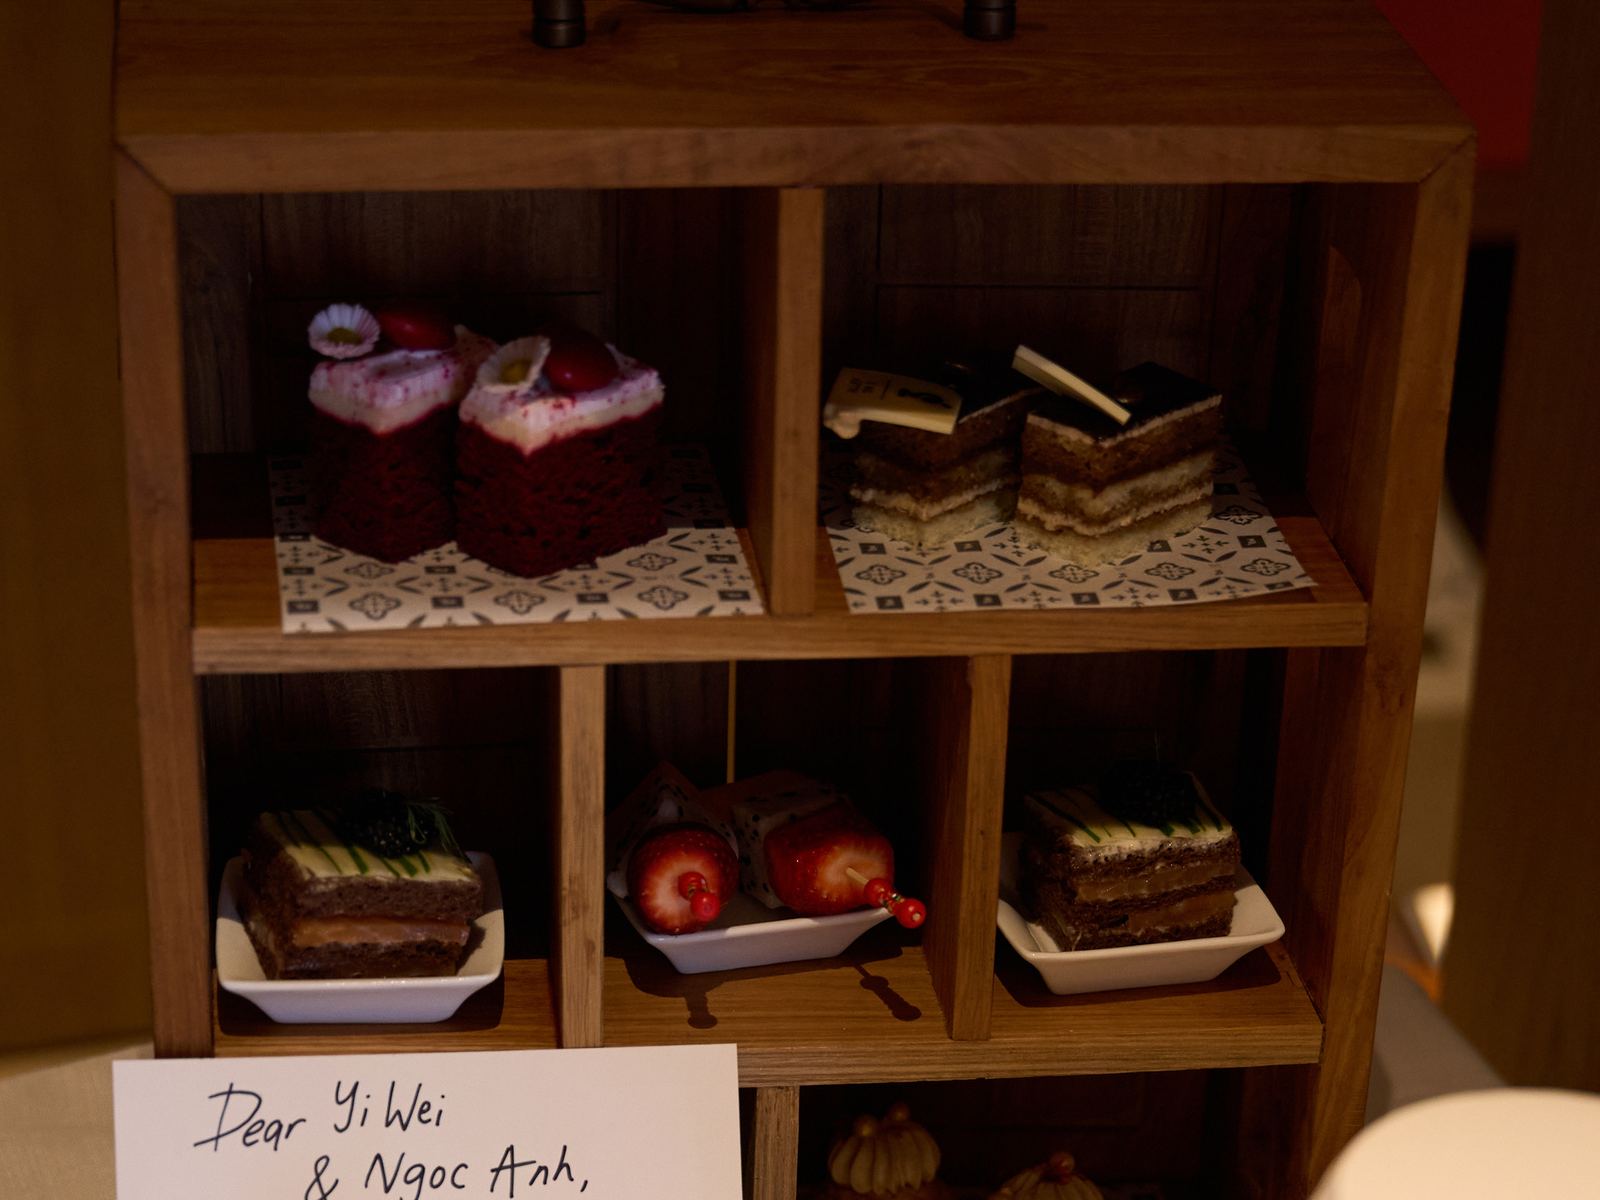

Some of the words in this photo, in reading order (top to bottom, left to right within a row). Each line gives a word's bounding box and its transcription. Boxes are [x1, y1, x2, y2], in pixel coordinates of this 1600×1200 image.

[193, 1082, 307, 1152] Dear
[333, 1080, 371, 1133] Yi
[384, 1080, 446, 1132] Wei
[489, 1145, 589, 1199] Anh,
